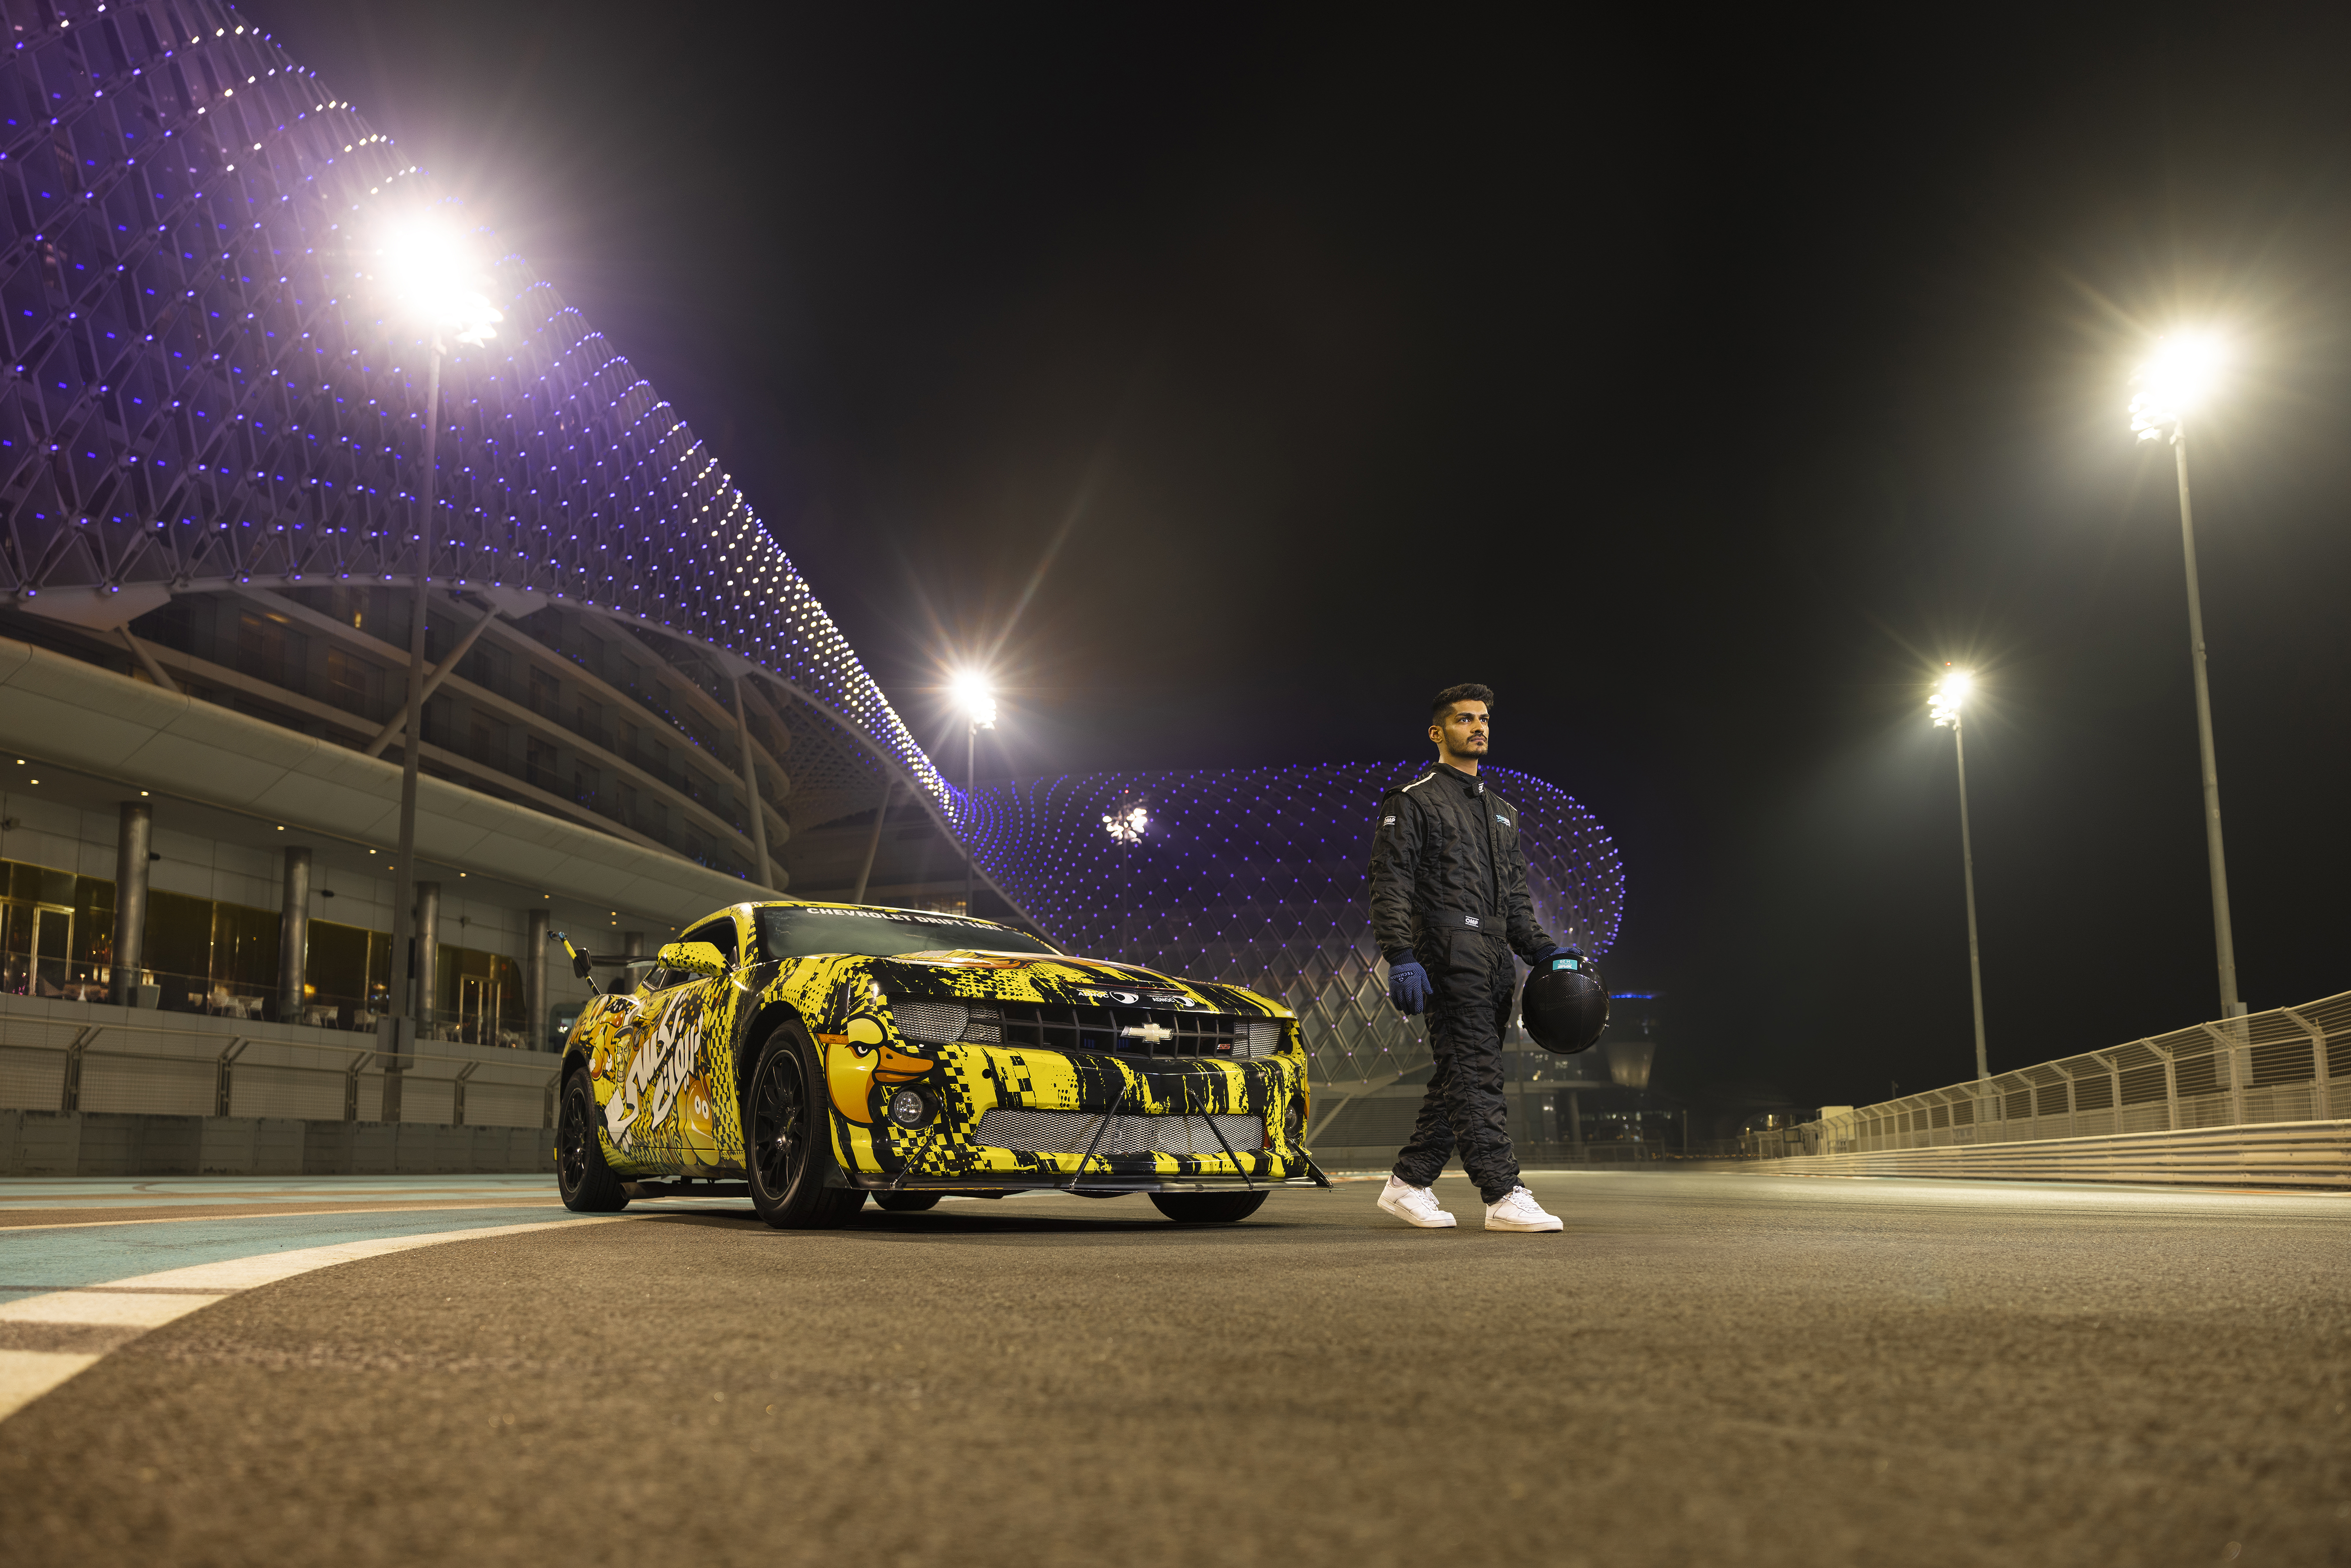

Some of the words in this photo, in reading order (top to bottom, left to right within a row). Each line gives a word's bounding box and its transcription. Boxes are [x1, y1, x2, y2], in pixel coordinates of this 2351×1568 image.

[806, 907, 912, 922] CHEVROLET
[914, 916, 964, 926] DRIFT
[965, 921, 1003, 932] TAXI
[1390, 971, 1414, 980] TECHTION
